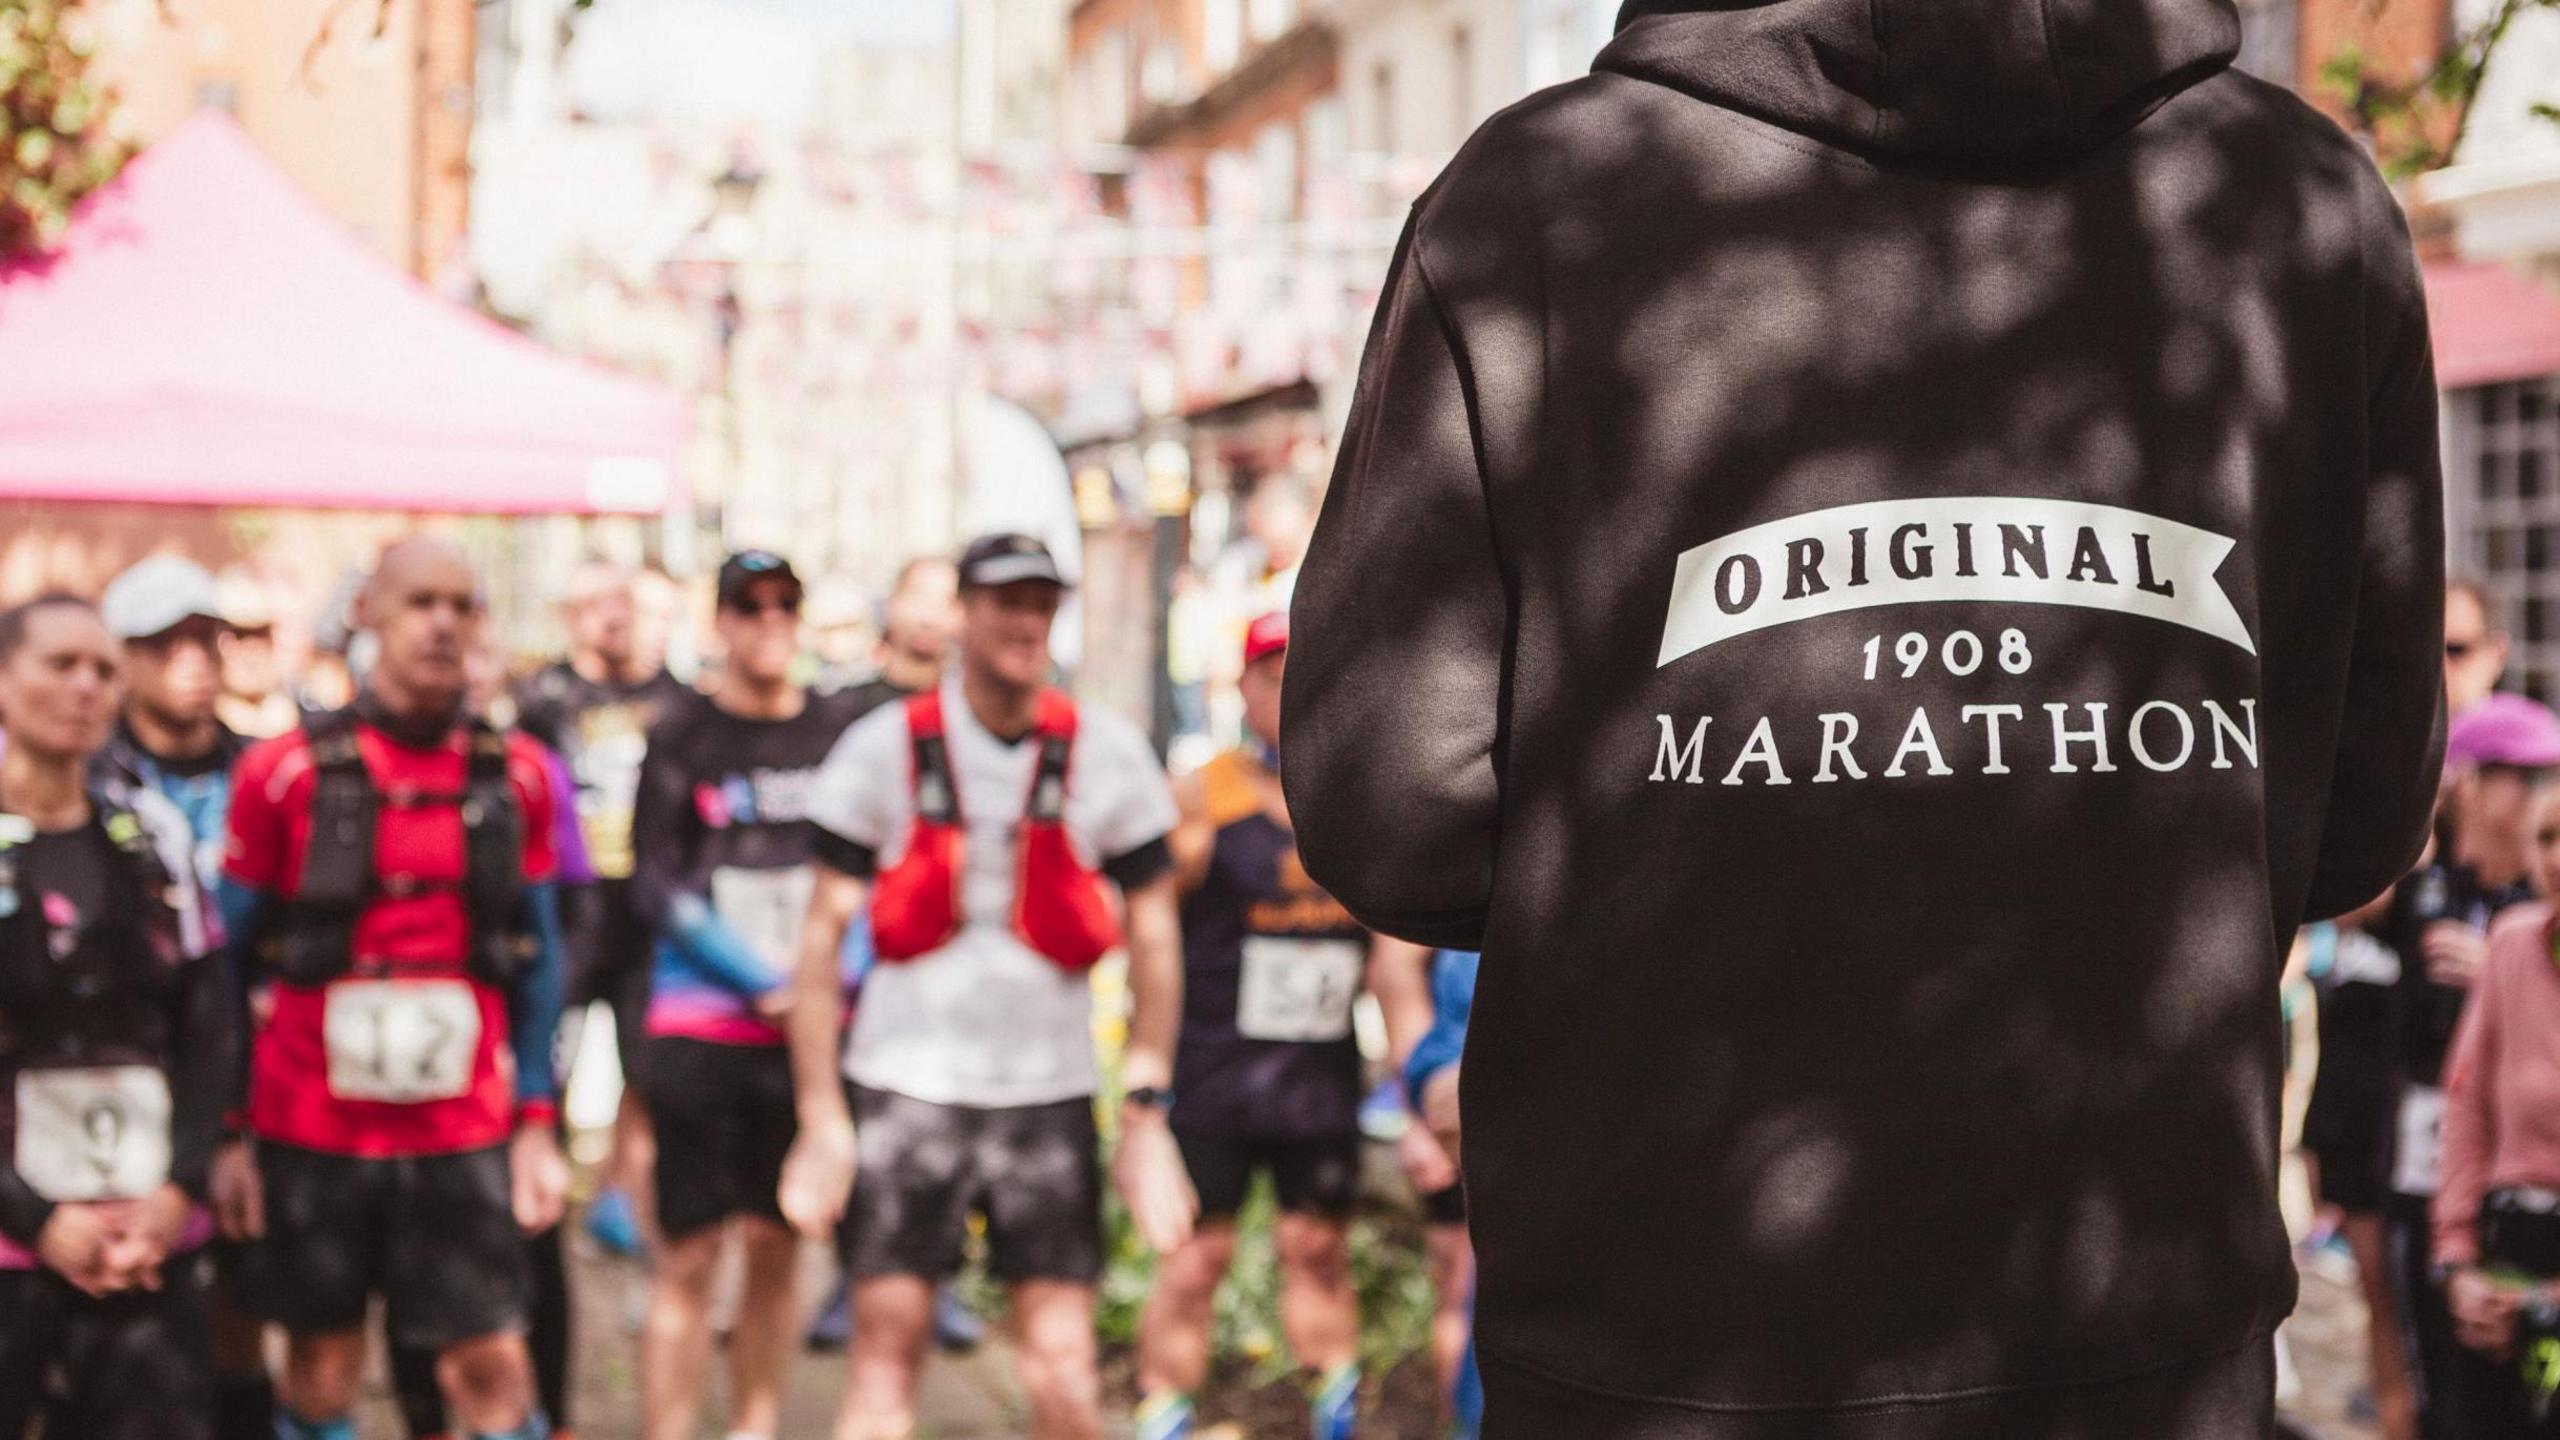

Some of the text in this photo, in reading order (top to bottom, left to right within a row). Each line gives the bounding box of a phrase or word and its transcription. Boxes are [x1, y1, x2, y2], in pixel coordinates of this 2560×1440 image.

[1714, 522, 2175, 615] ORIGINAL
[1863, 628, 2032, 680] 1908
[1649, 699, 2259, 785] MARATHON
